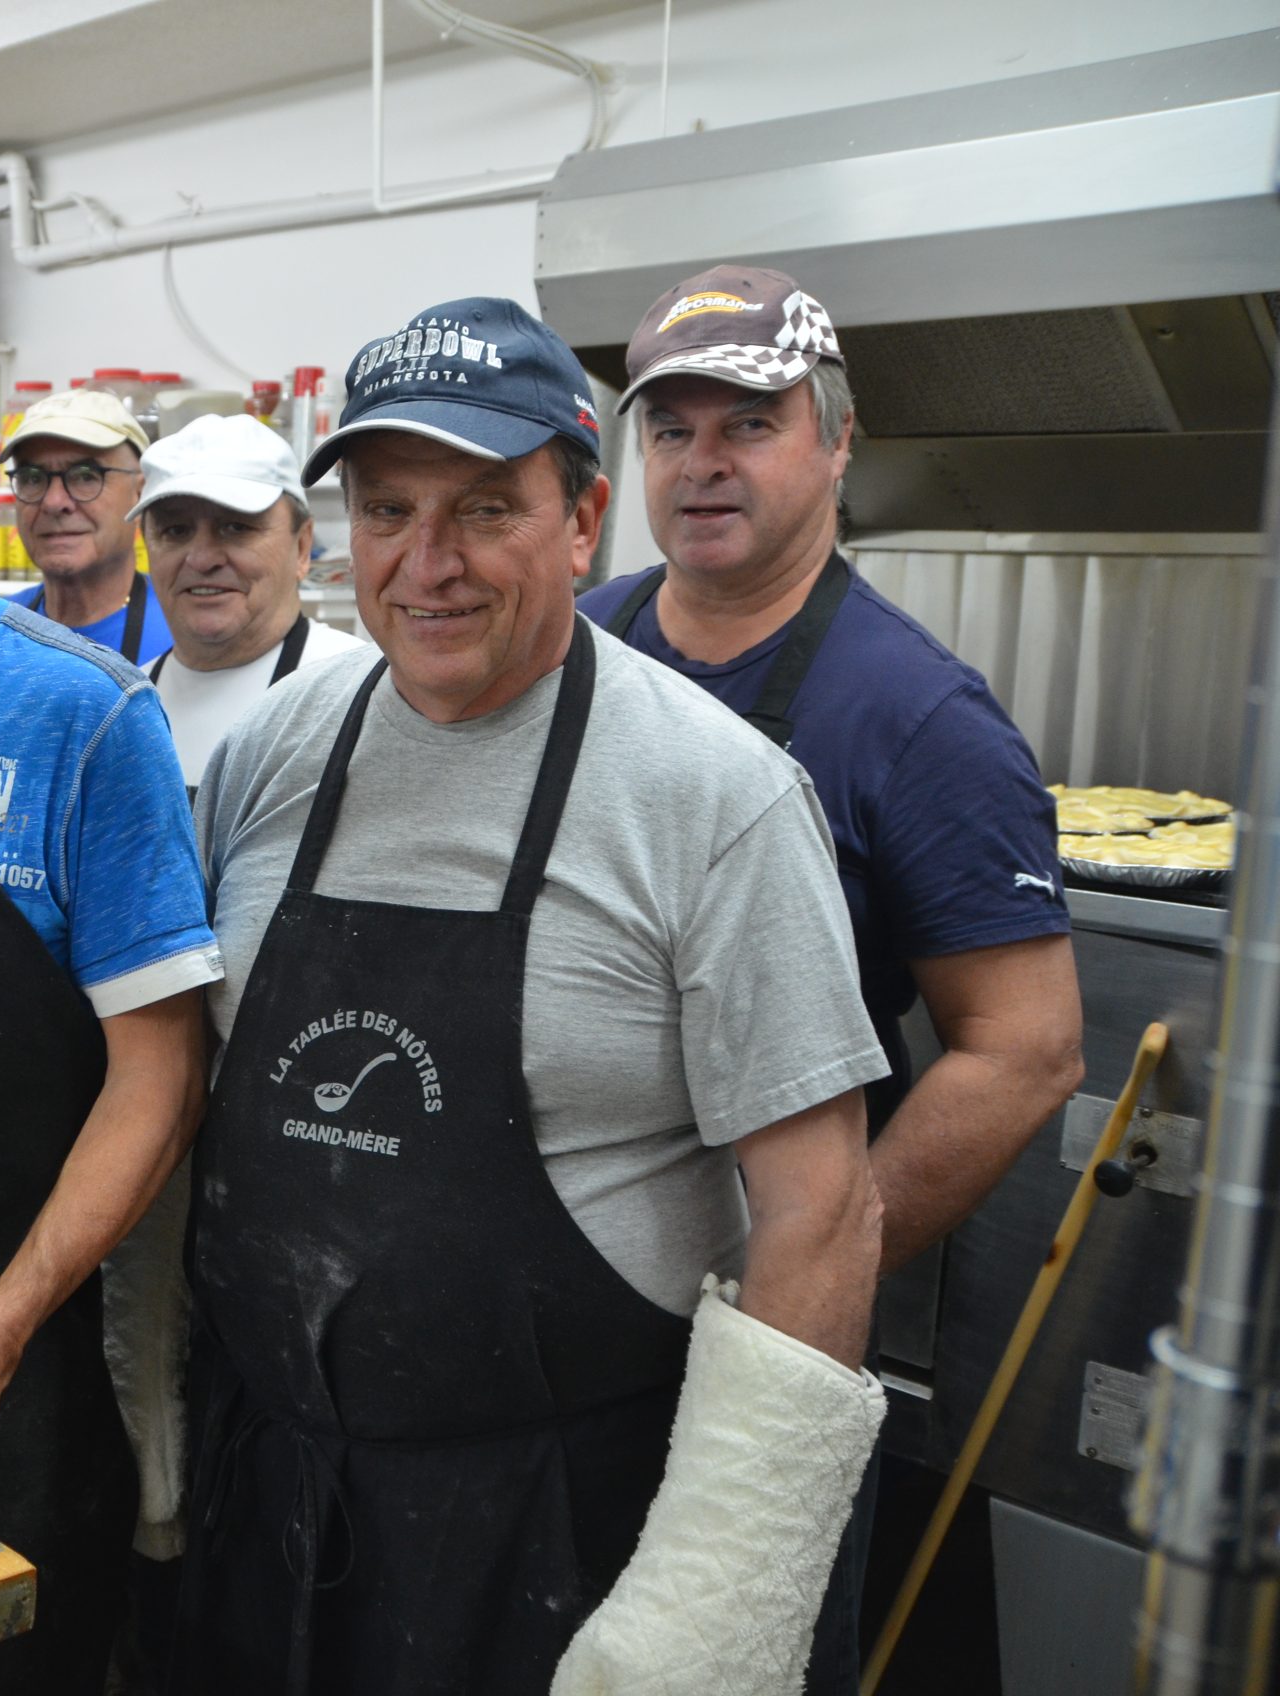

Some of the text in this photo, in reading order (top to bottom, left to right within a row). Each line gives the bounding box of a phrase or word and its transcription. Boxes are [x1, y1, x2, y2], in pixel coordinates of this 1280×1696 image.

[354, 328, 502, 386] SUPERBOWL
[392, 356, 431, 374] LII
[364, 370, 468, 396] MINNESOTA
[269, 1009, 443, 1113] LA TABLÉE DES NÔTRES
[282, 1118, 401, 1157] GRAND-MÈRE
